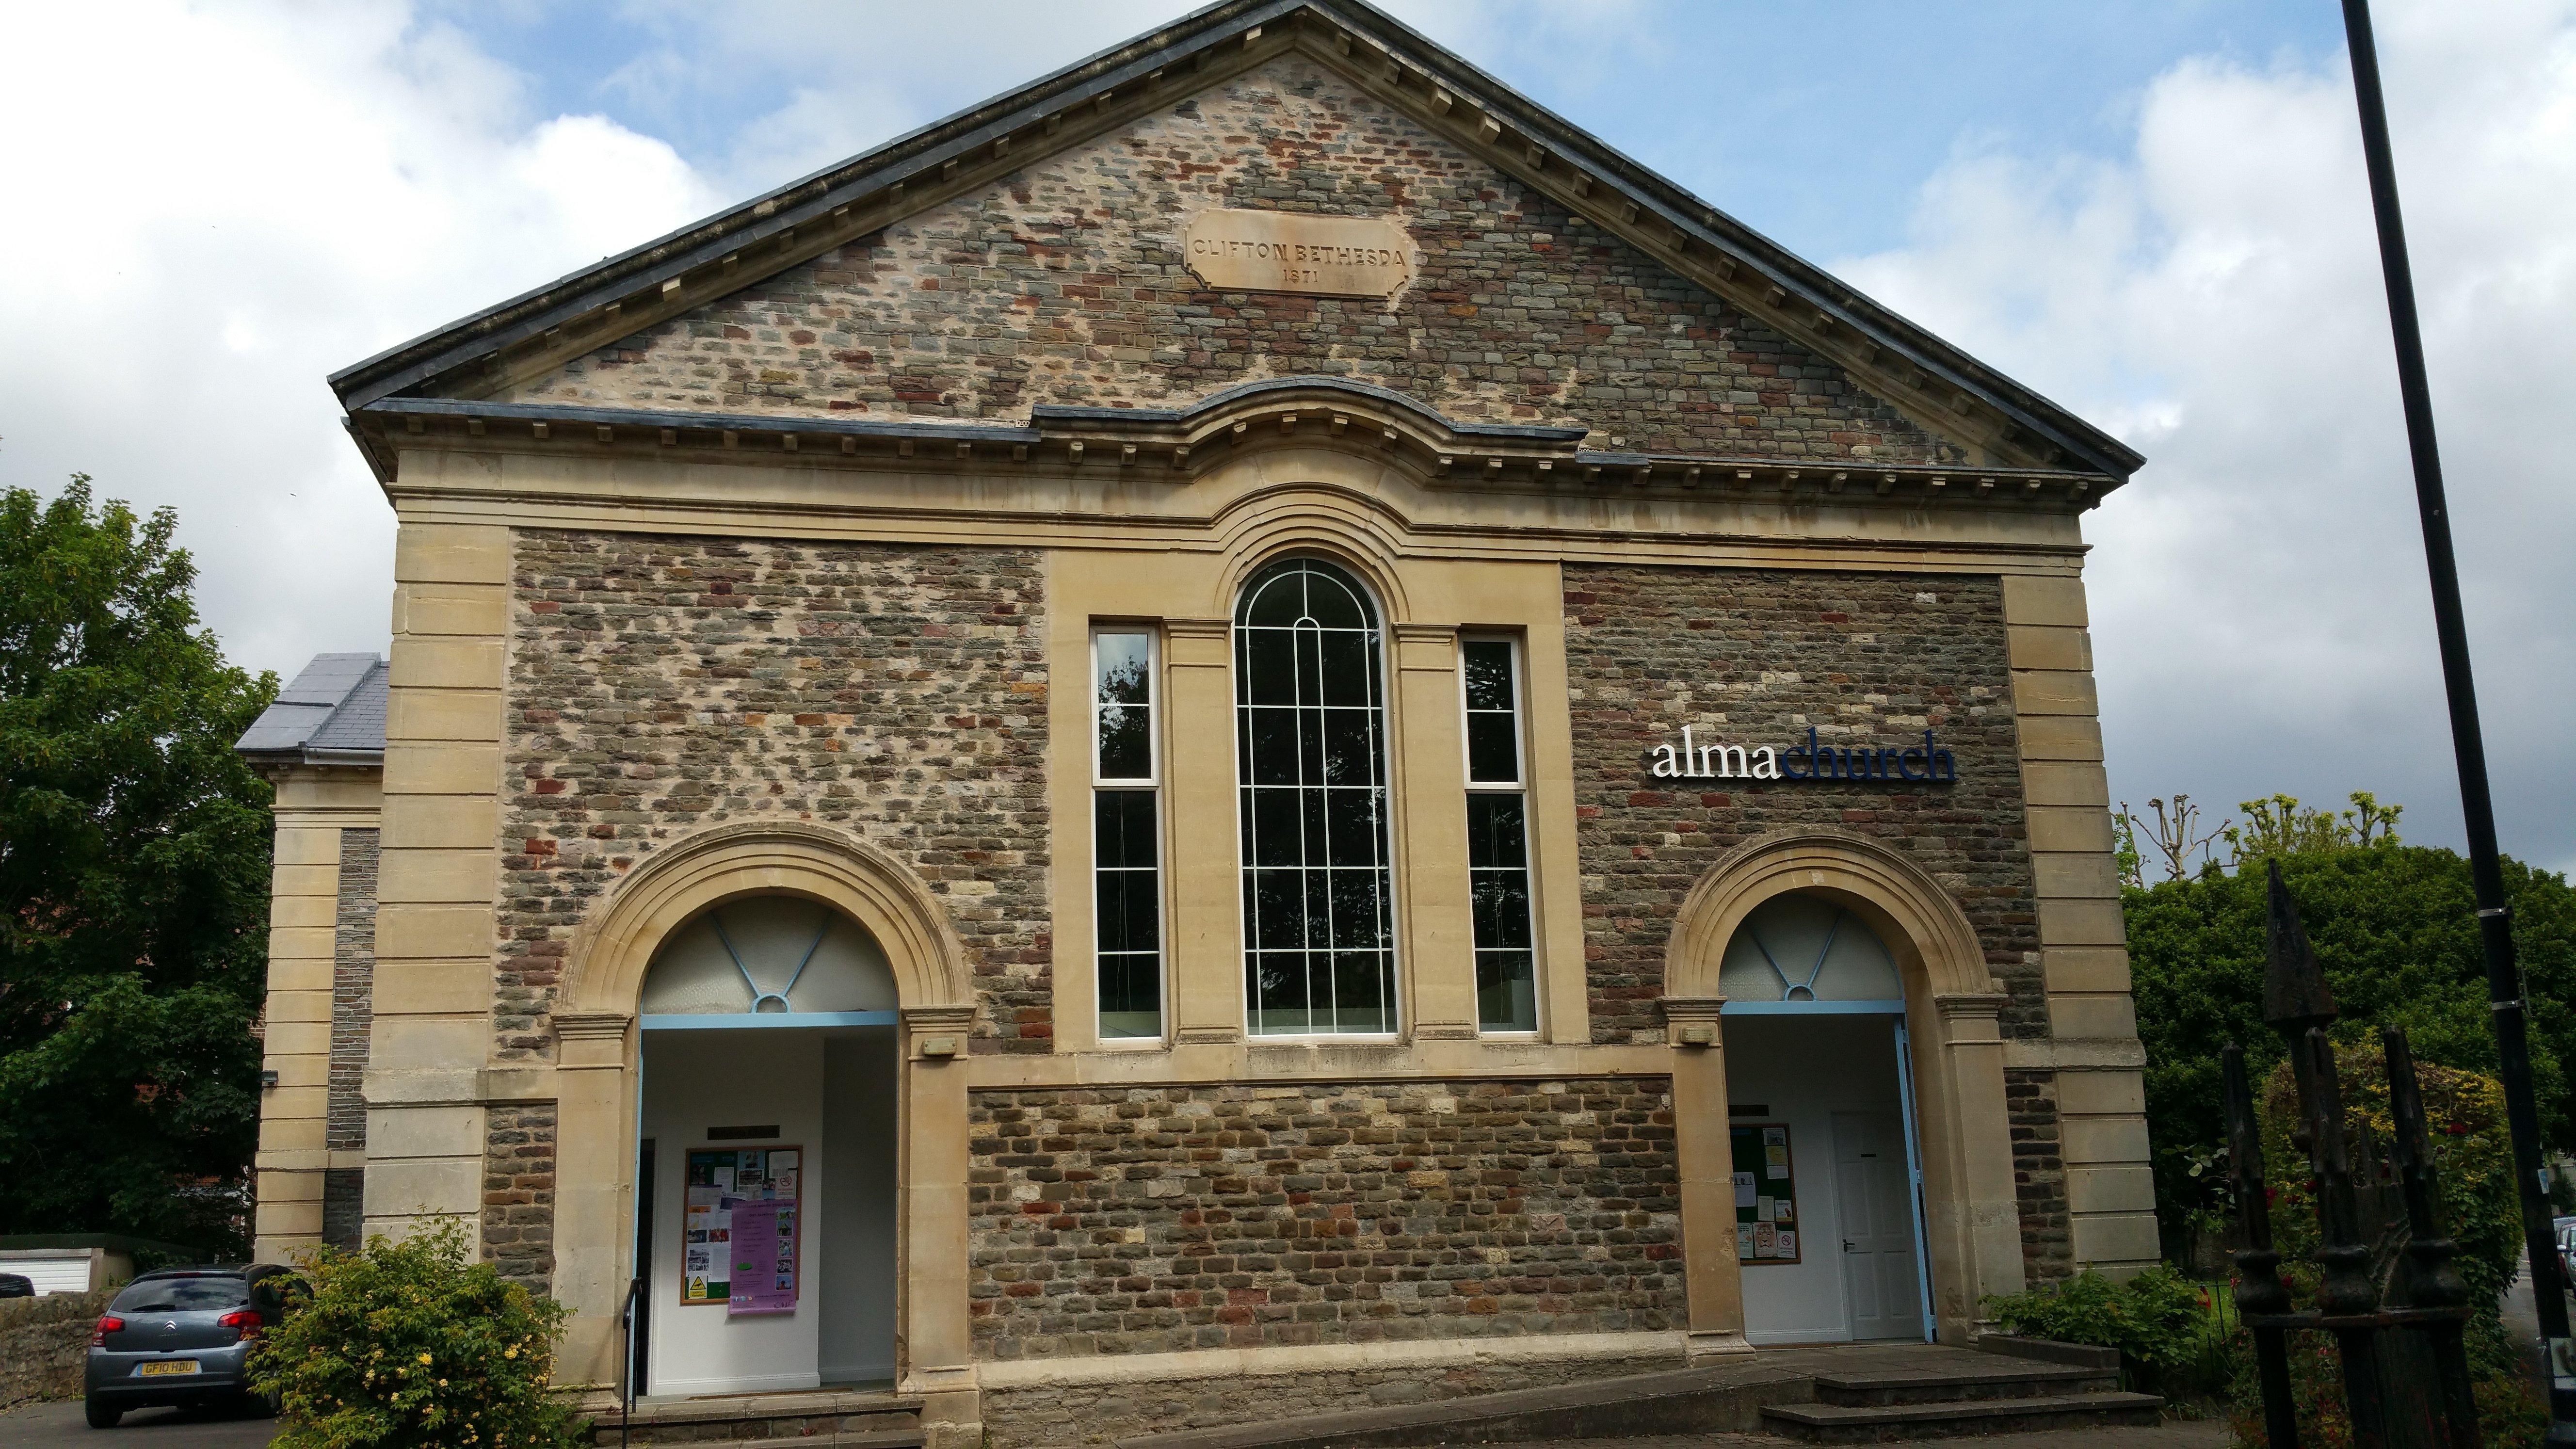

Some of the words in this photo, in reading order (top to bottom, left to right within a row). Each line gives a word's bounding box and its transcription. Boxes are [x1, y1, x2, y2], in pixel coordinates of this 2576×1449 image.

[1193, 239, 1288, 261] CLIFTON
[1294, 244, 1407, 267] BETHESDA
[1283, 269, 1319, 284] 1871
[145, 1363, 170, 1373] GF10
[171, 1362, 193, 1372] HDU
